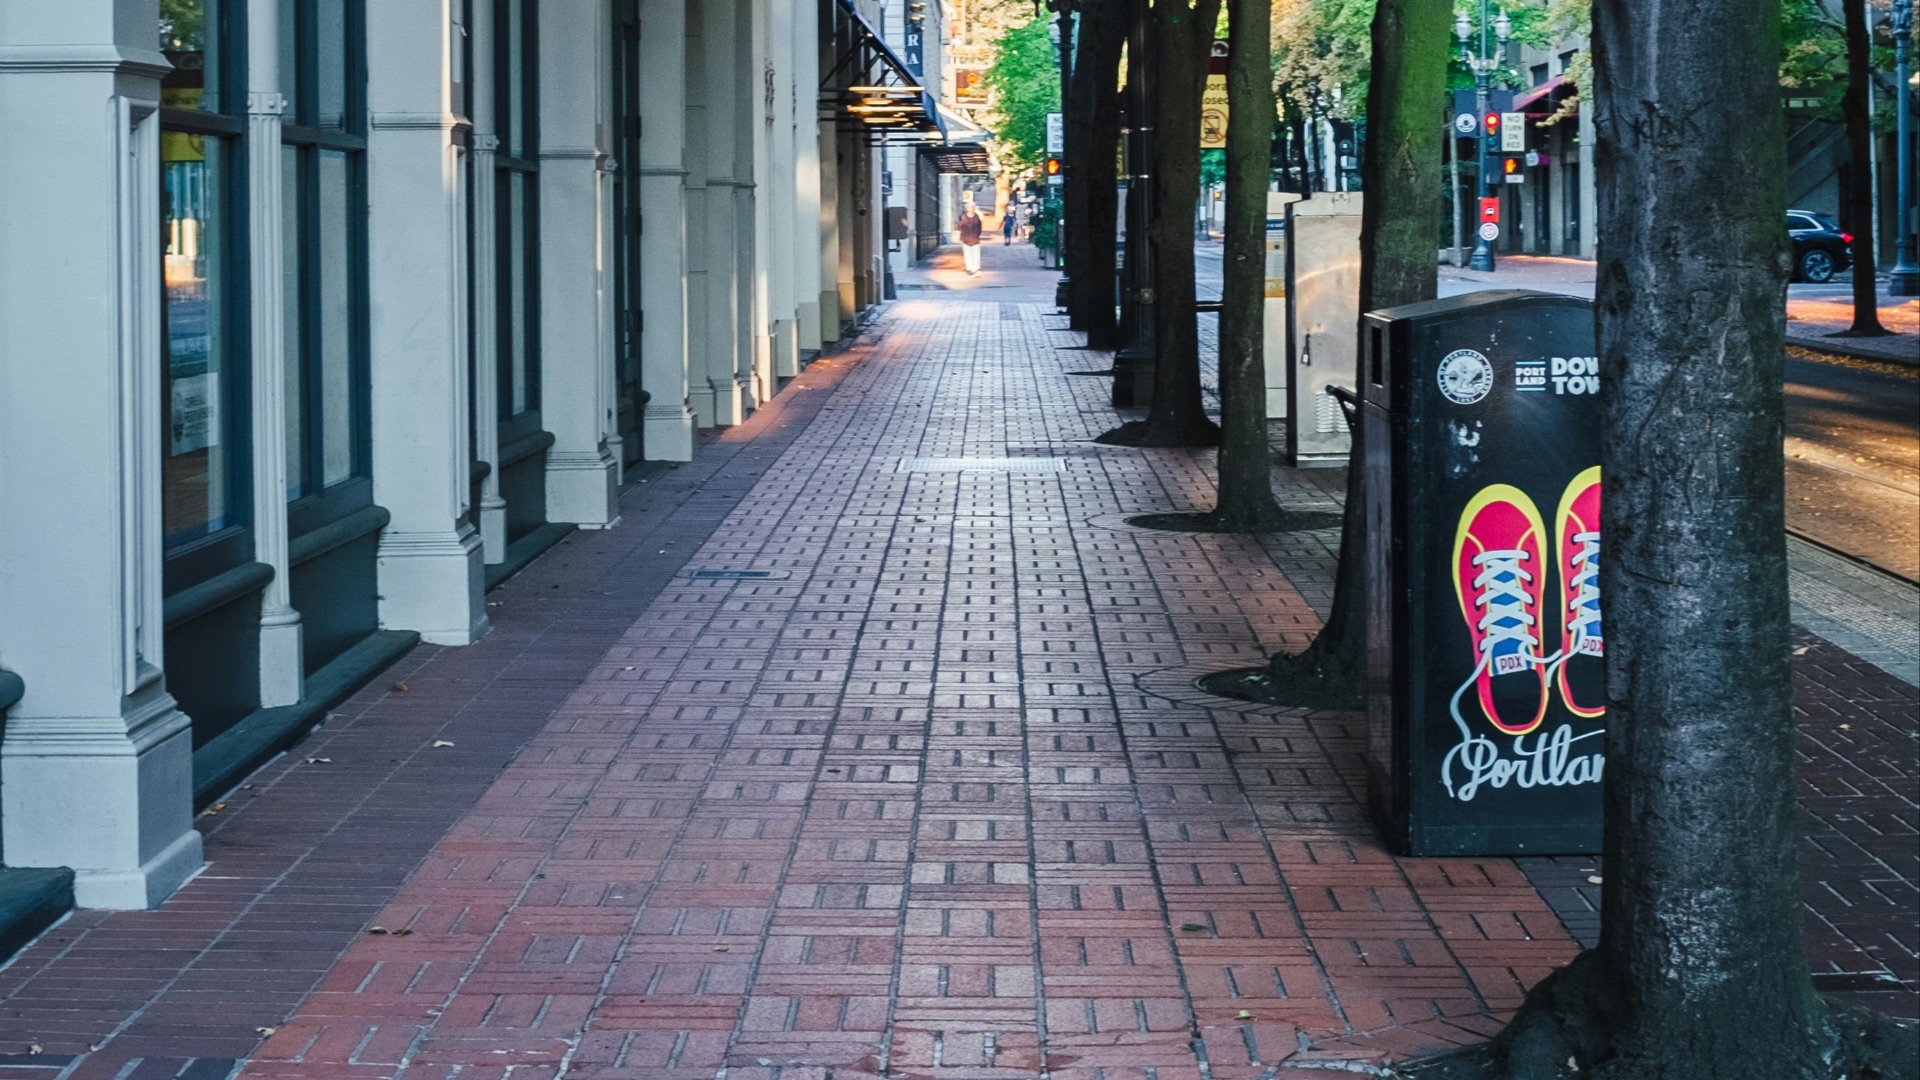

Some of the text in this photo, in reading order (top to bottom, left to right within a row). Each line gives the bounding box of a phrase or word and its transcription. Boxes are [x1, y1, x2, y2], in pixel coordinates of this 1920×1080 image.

[1506, 115, 1521, 123] NO
[1515, 367, 1546, 376] PORT
[1551, 357, 1599, 375] DOW
[1515, 377, 1546, 385] LAND
[1551, 376, 1600, 395] TOW
[1500, 655, 1524, 671] PDX
